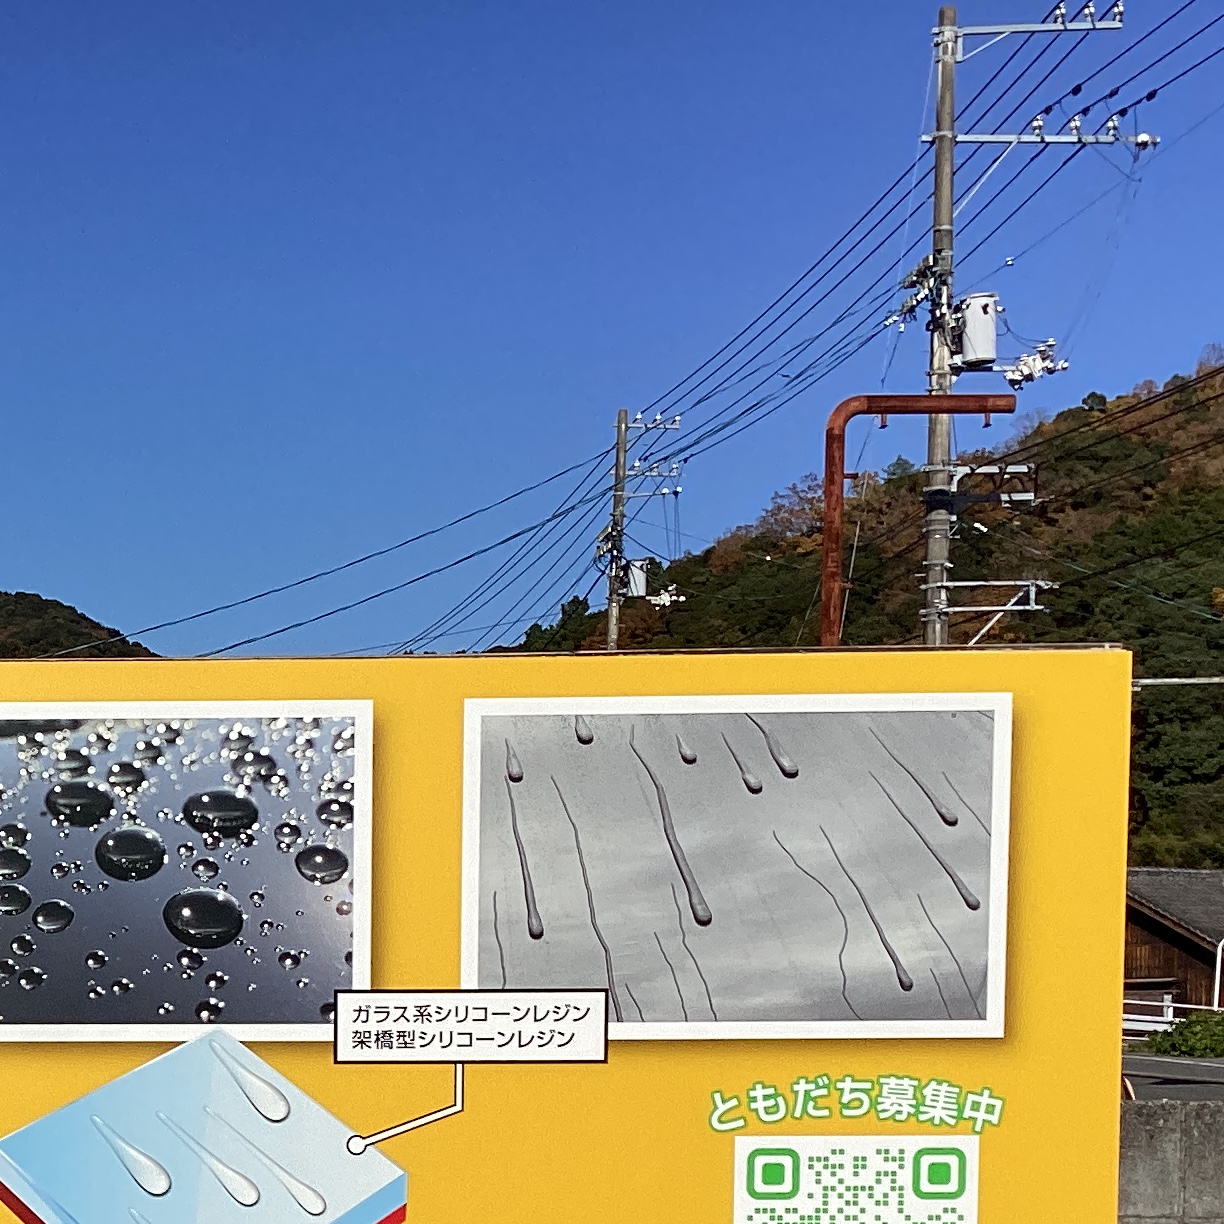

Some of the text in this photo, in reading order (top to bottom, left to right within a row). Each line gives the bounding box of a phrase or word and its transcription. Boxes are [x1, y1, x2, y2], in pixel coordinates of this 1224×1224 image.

[351, 1003, 591, 1025] ガラス系シリコーンレジン
[351, 1028, 576, 1050] 架橋型シリコーンレジン
[710, 1074, 1003, 1132] ともだち募集中
